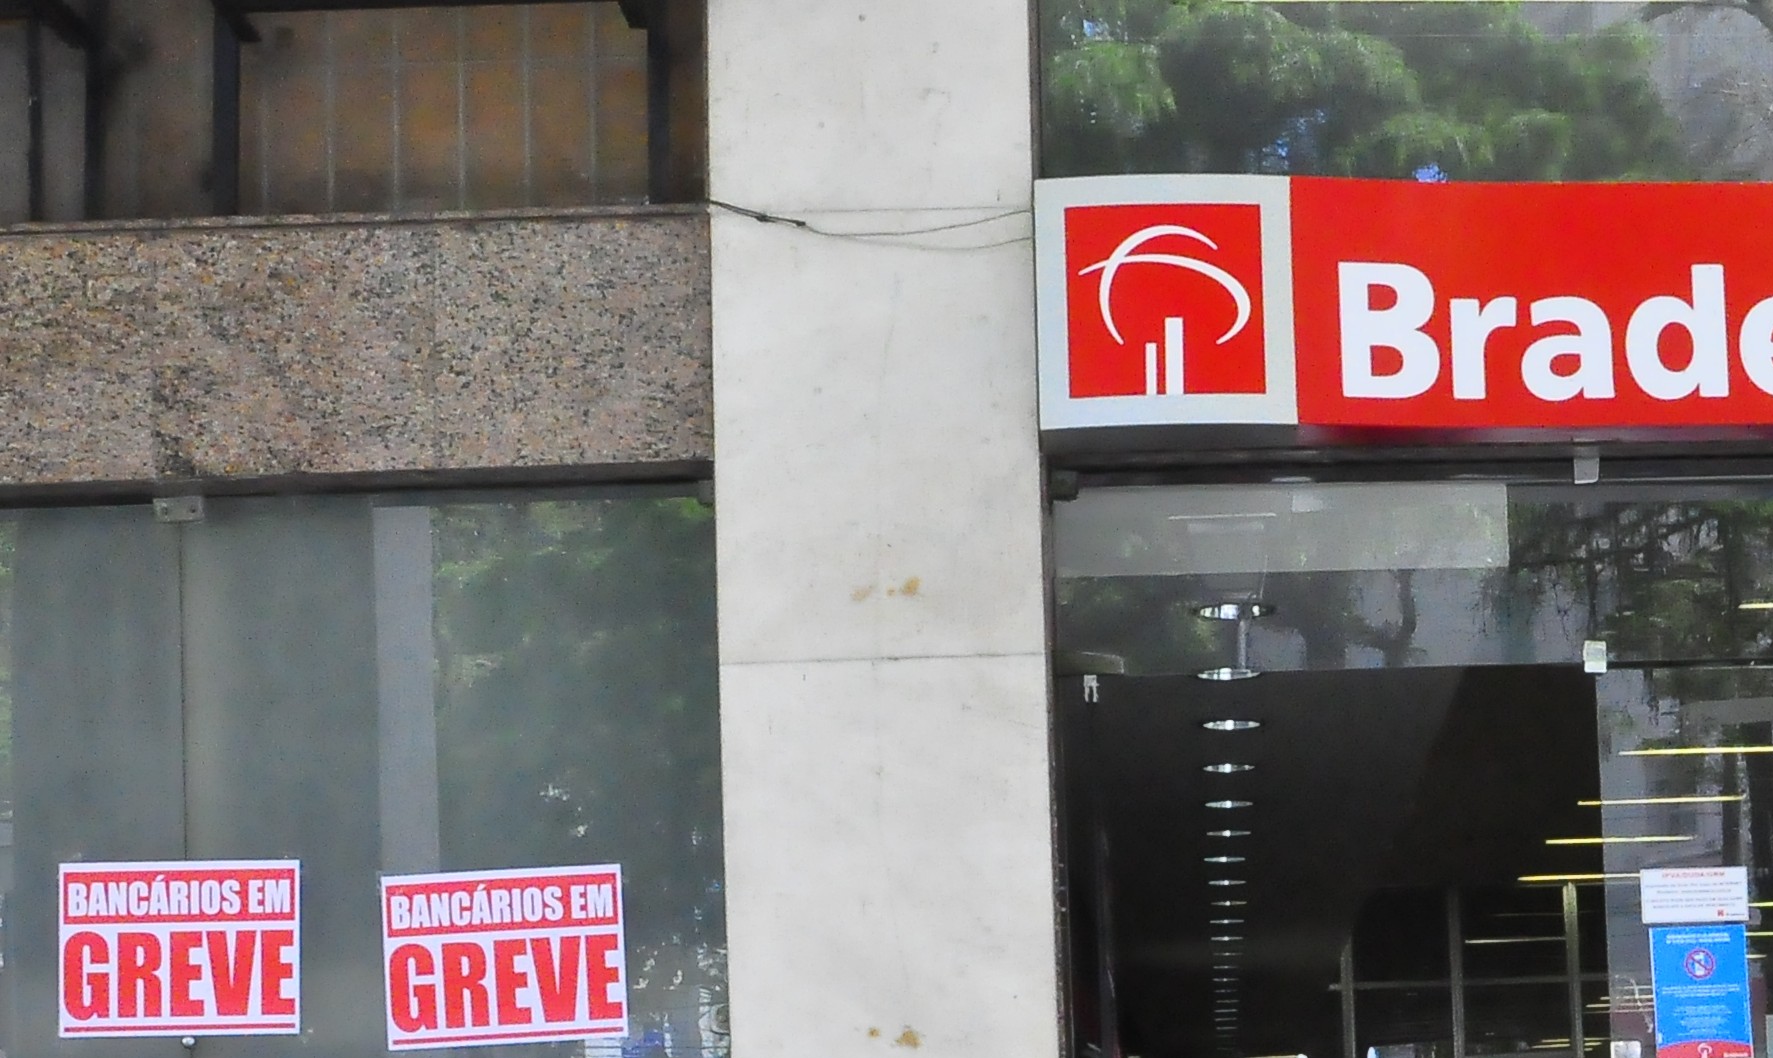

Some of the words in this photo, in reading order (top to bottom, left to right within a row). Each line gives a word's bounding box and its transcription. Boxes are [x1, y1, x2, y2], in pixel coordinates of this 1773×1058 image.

[67, 875, 240, 914] BANCÁRIOS
[248, 878, 290, 913] EM
[391, 884, 564, 930] BANCÁRIOS
[571, 883, 613, 919] EM
[63, 930, 295, 1021] GREVE
[388, 935, 623, 1033] GREVE
